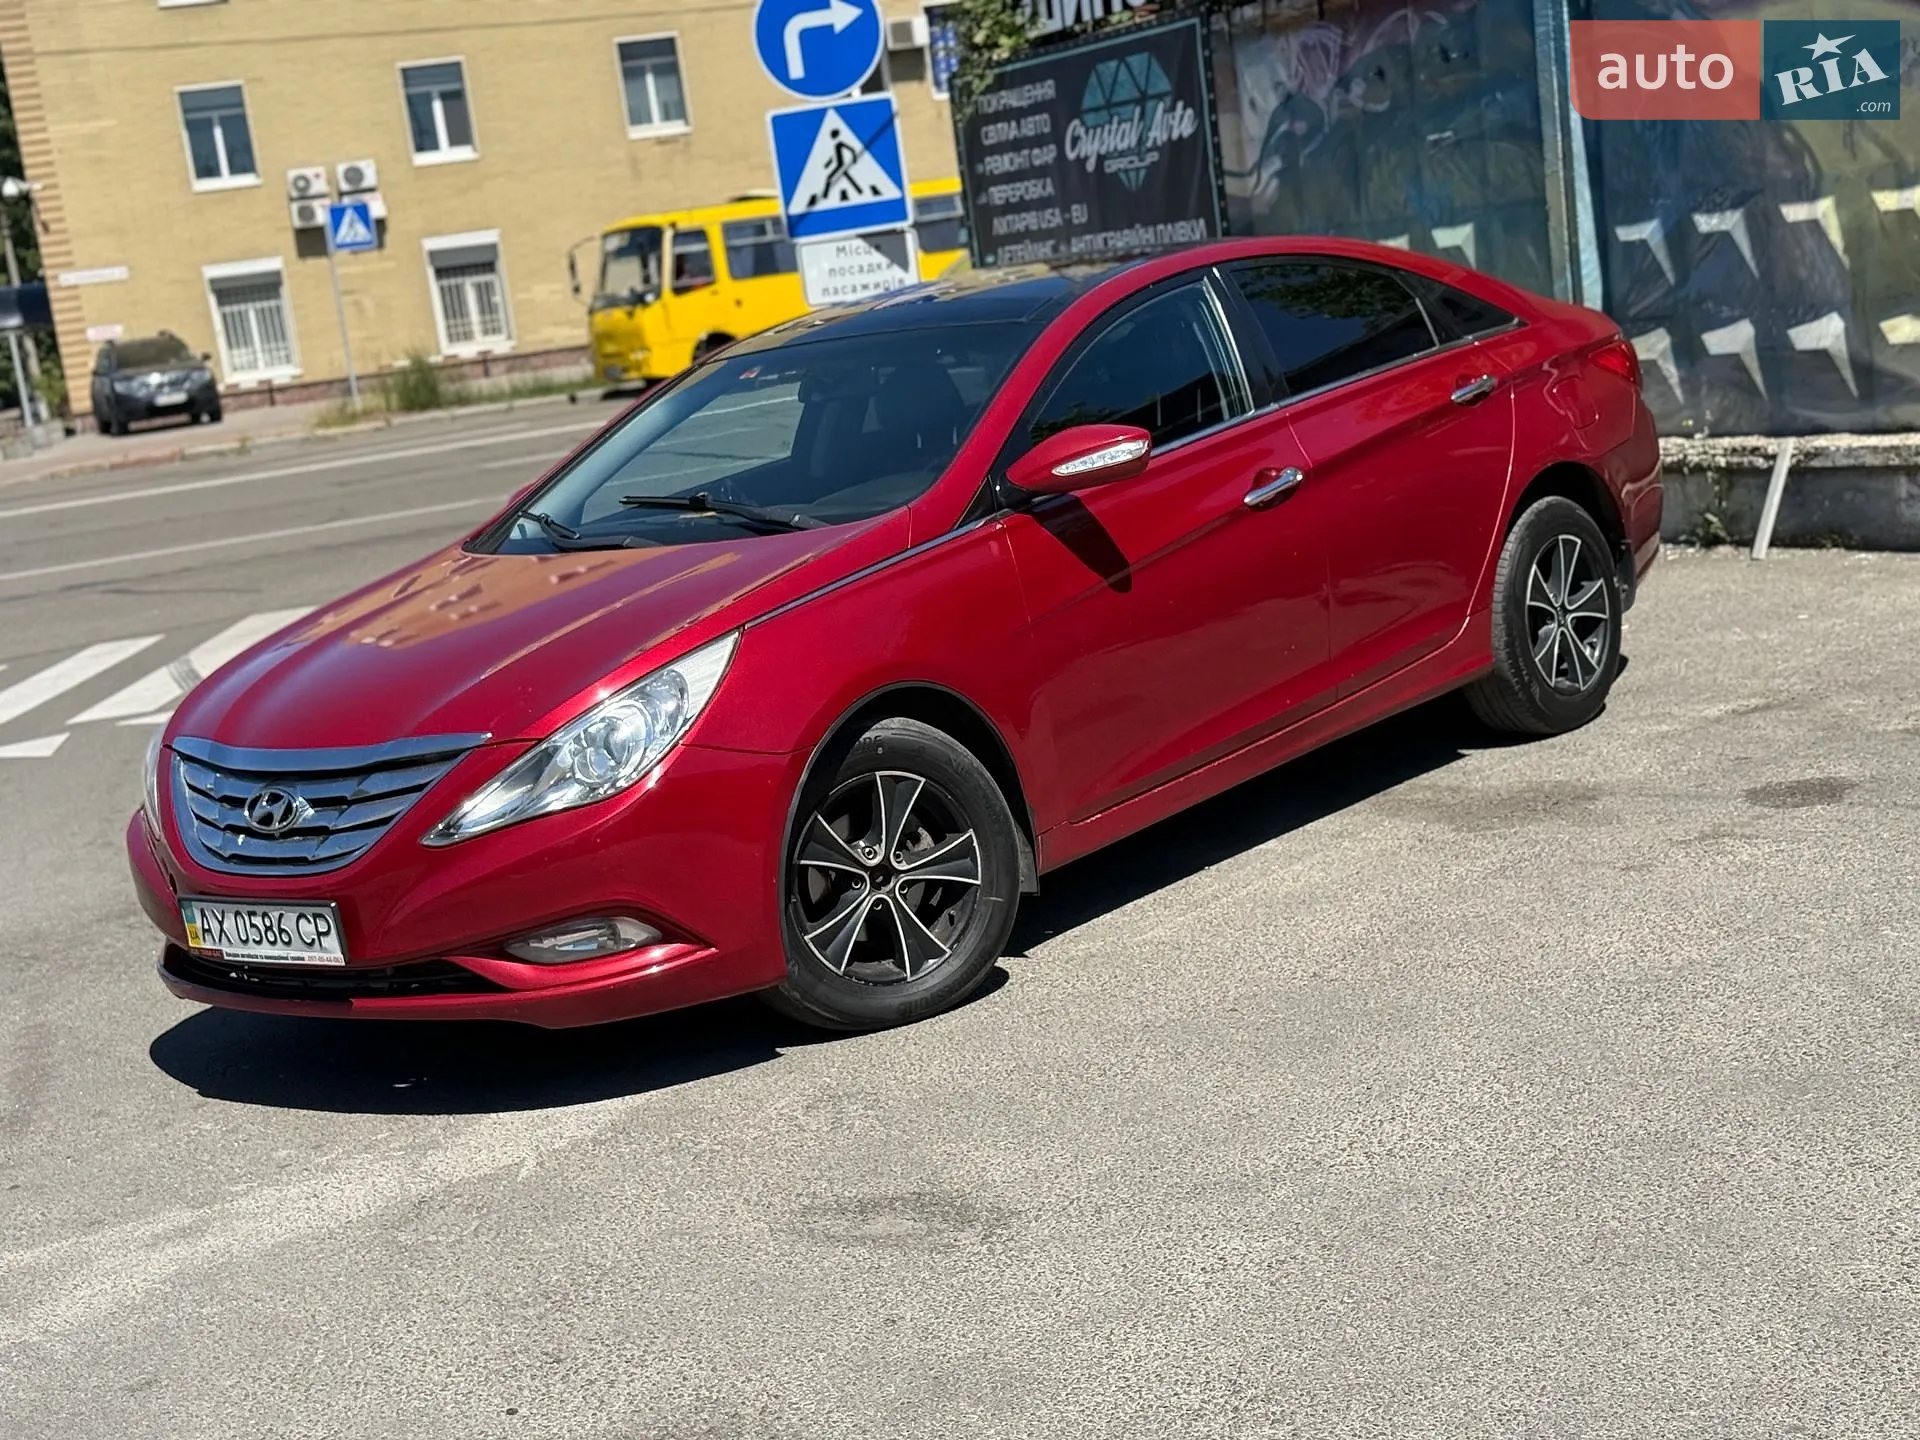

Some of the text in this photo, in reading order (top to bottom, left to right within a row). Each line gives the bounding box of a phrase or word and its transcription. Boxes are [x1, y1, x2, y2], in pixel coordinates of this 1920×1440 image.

[1065, 105, 1144, 173] Crystal
[984, 143, 1057, 176] РЕМОНТ ФАР
[1103, 151, 1160, 173] GROUP
[988, 177, 1055, 206] ПЕРЕРОБКА
[1039, 207, 1063, 229] USA
[1071, 203, 1088, 225] EU
[200, 907, 332, 950] AX 0586 CP
